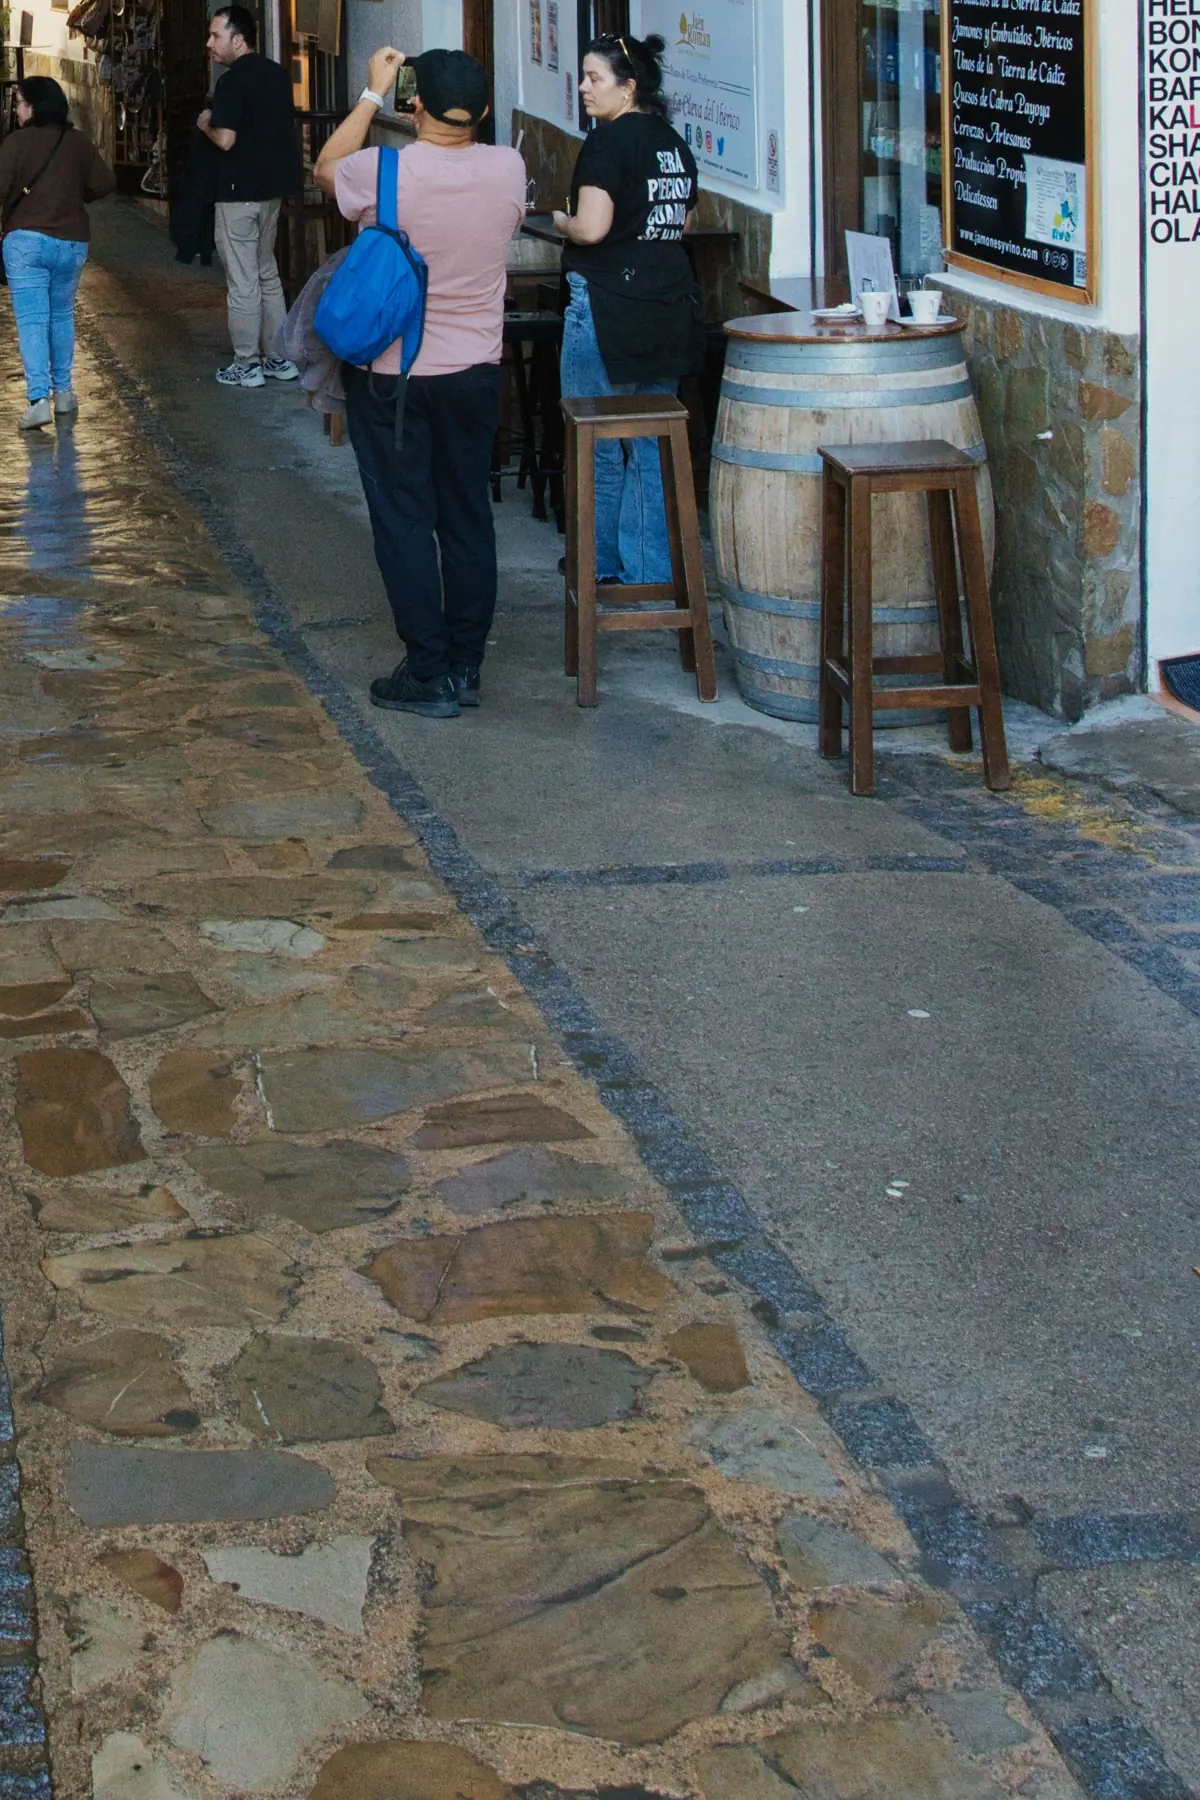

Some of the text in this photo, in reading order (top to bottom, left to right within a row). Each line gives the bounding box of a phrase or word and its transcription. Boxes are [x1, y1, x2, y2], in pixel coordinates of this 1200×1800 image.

[952, 16, 1073, 51] Jamones y Embutidos Ibéricos
[954, 49, 1066, 85] Vinos de la Tierra de Cádiz
[953, 81, 1050, 125] Quesos de Cabra Payoya
[953, 115, 1031, 149] Cervezas Artesanas
[656, 147, 685, 173] SERÁ
[954, 147, 995, 176] Producción
[1150, 162, 1200, 187] CIA
[954, 180, 998, 210] Delicatessen
[960, 228, 1038, 260] www.jamonesyvino.com
